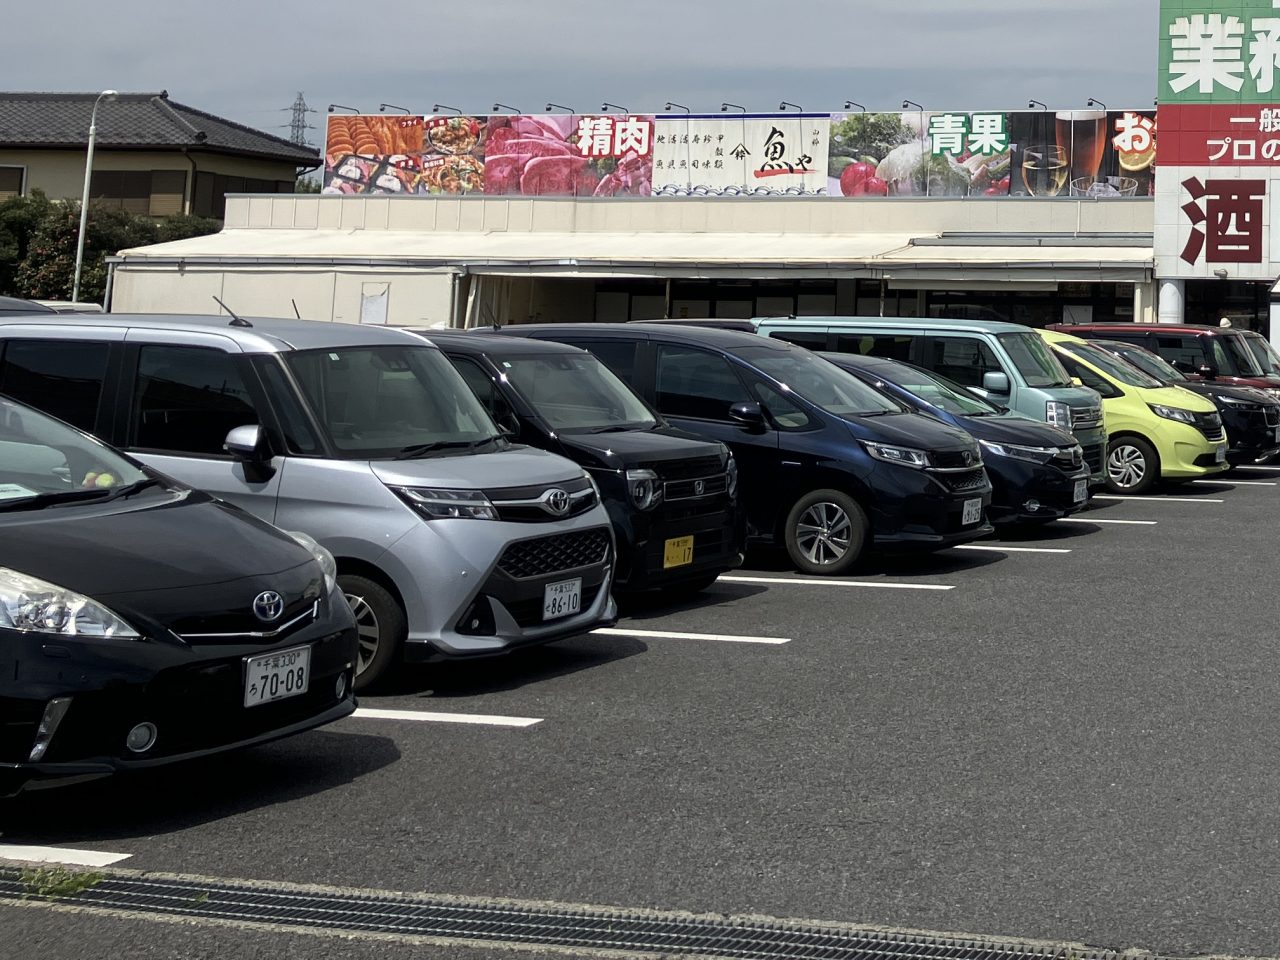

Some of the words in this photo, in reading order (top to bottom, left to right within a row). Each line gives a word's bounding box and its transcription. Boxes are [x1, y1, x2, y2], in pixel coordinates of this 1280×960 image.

[577, 117, 650, 156] 精肉
[928, 114, 1008, 155] 青果
[1113, 112, 1157, 152] お
[1180, 176, 1266, 267] 酒
[261, 667, 304, 699] 70-08
